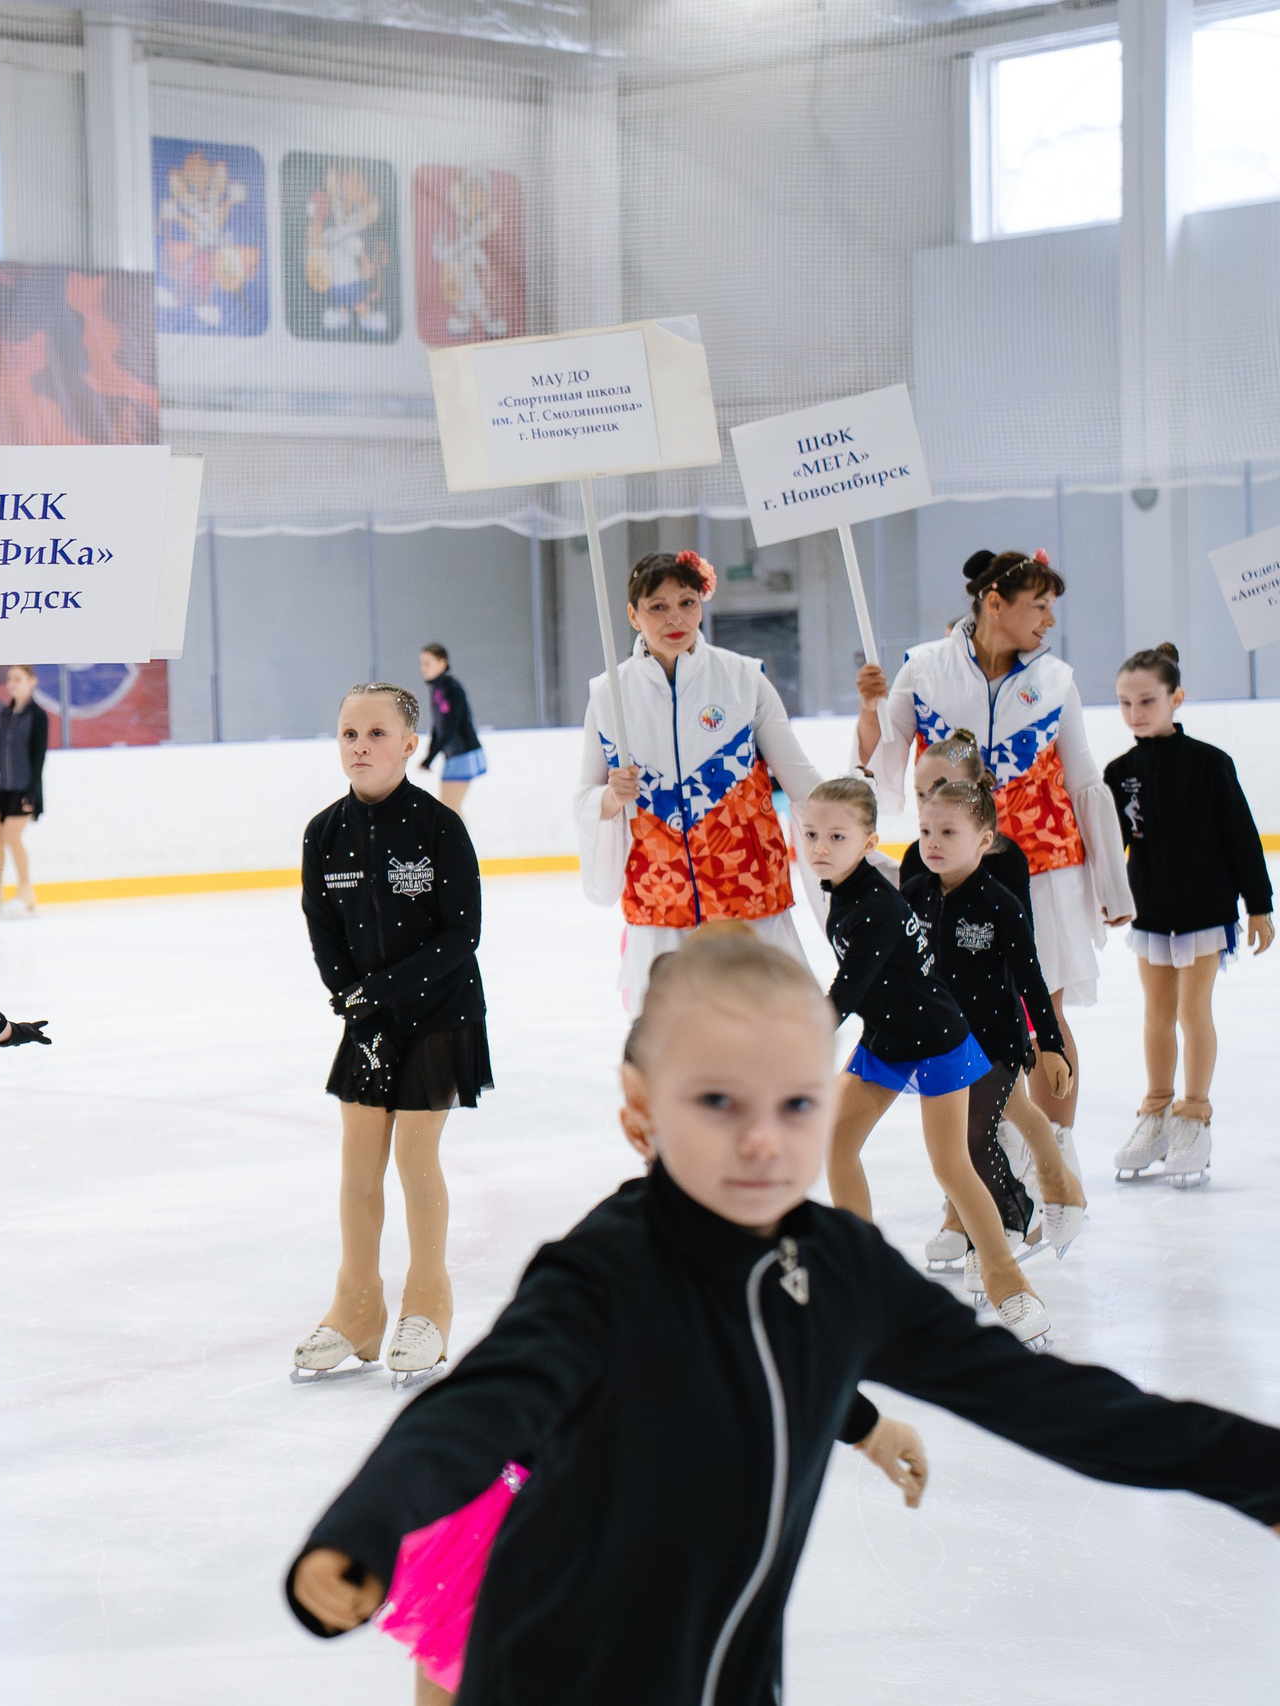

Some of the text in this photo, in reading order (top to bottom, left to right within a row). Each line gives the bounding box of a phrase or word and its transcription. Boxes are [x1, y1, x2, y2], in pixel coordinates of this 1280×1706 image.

[531, 369, 590, 387] МАУ ДО
[497, 384, 631, 408] «Спортивная школа
[492, 401, 643, 427] им. А.Г. Смолянинова»
[519, 421, 620, 441] г. Новокузнецк
[797, 427, 855, 455] ШФК
[792, 450, 870, 479] «МЕГА»
[763, 464, 911, 511] г. Новосибирск
